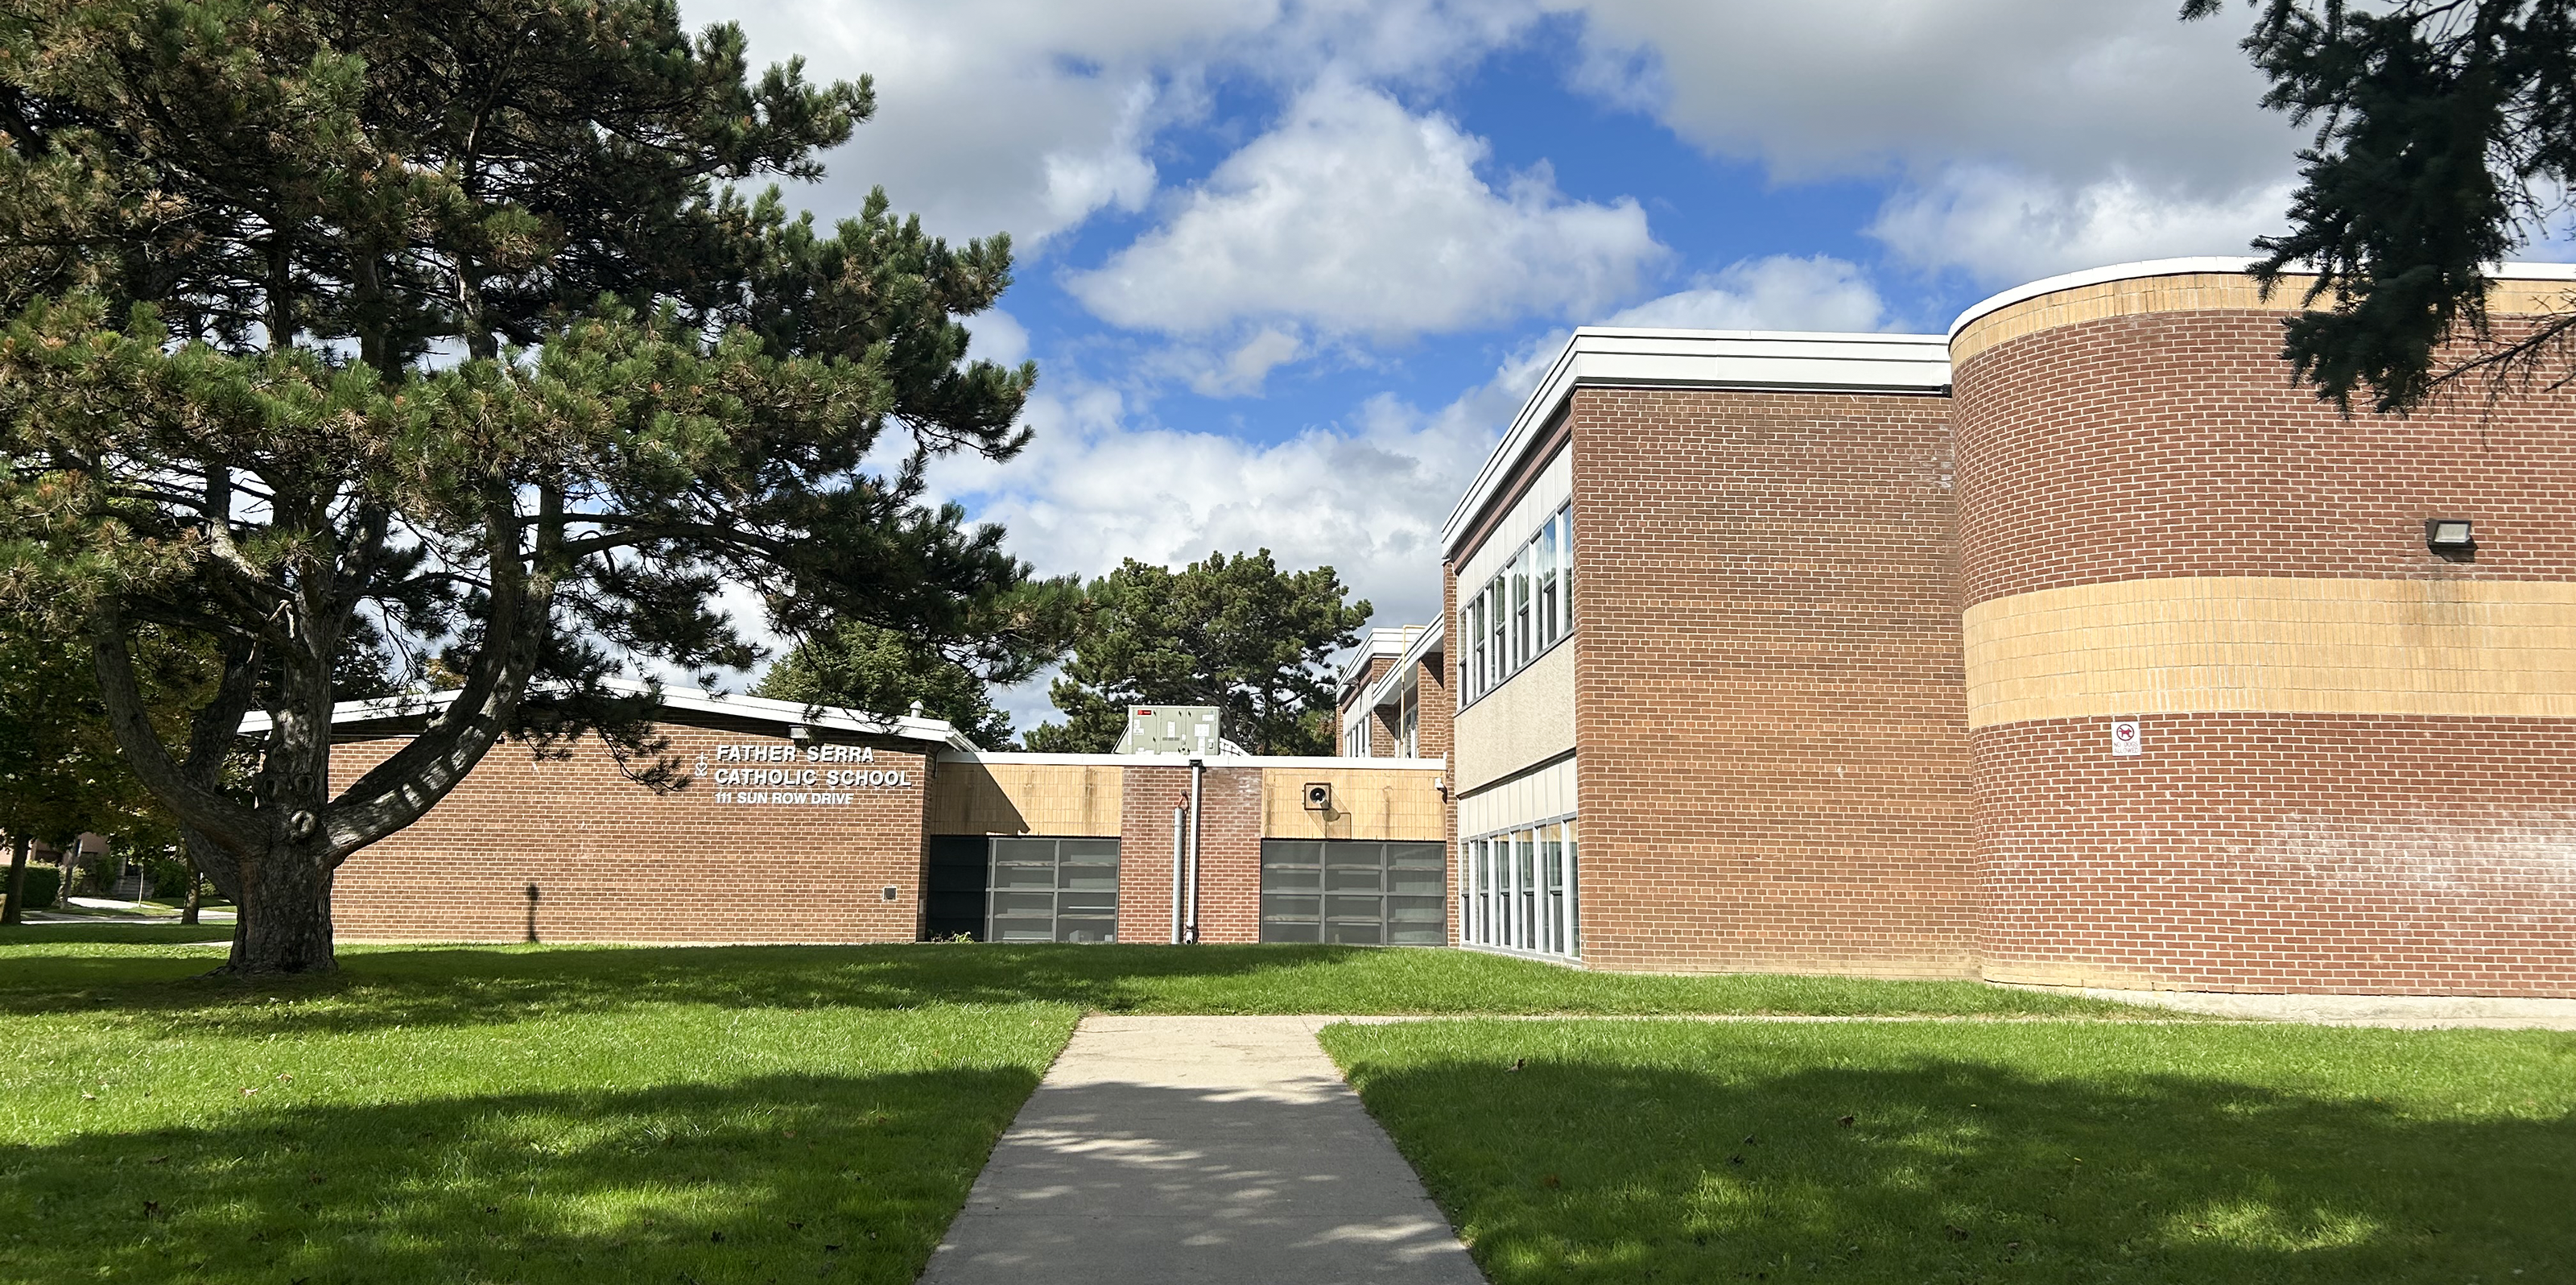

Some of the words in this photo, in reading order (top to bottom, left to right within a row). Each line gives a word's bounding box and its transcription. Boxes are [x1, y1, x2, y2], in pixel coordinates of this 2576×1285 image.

[716, 745, 796, 762] FATHER
[807, 746, 874, 762] SERRA
[714, 769, 817, 786] CATHOLIC
[827, 770, 912, 787] SCHOOL
[715, 792, 732, 804] 111
[737, 792, 768, 804] SUN
[772, 792, 807, 804] ROW
[811, 793, 855, 805] DRIVE
